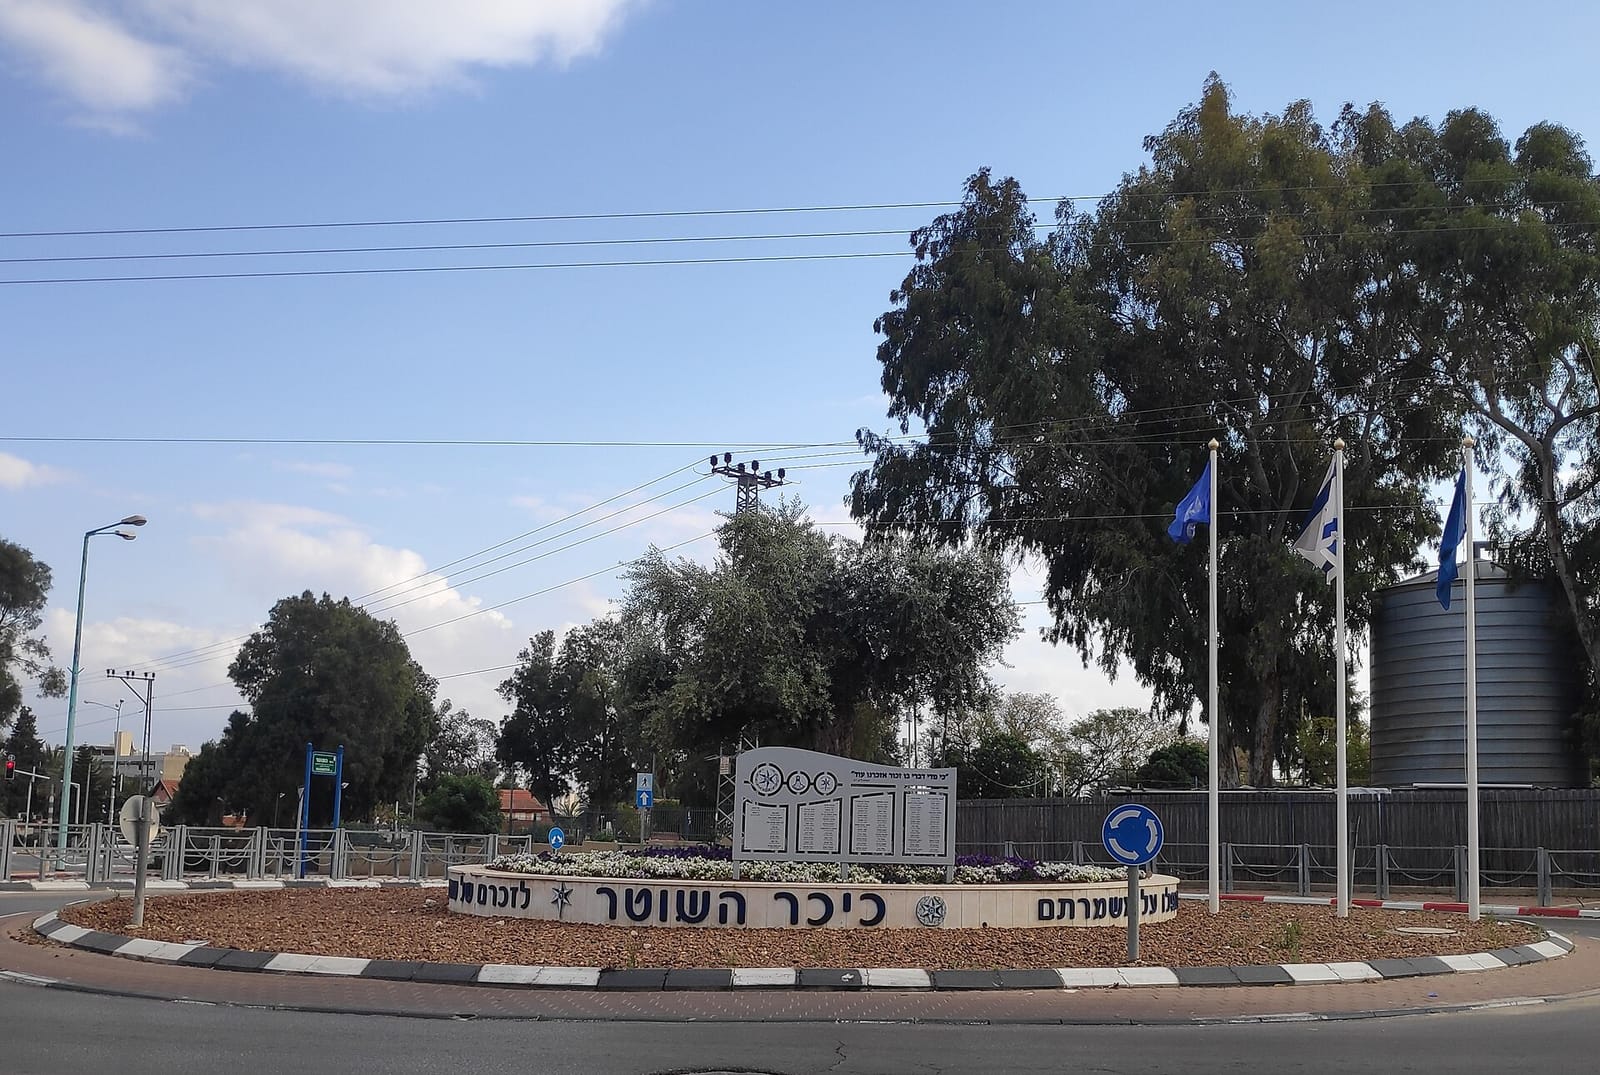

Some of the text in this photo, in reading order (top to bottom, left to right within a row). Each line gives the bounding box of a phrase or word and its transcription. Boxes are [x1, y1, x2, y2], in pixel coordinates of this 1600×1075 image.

[476, 879, 531, 910] לזכרם
[596, 887, 887, 927] כיכר השוטר
[1140, 888, 1158, 915] על
